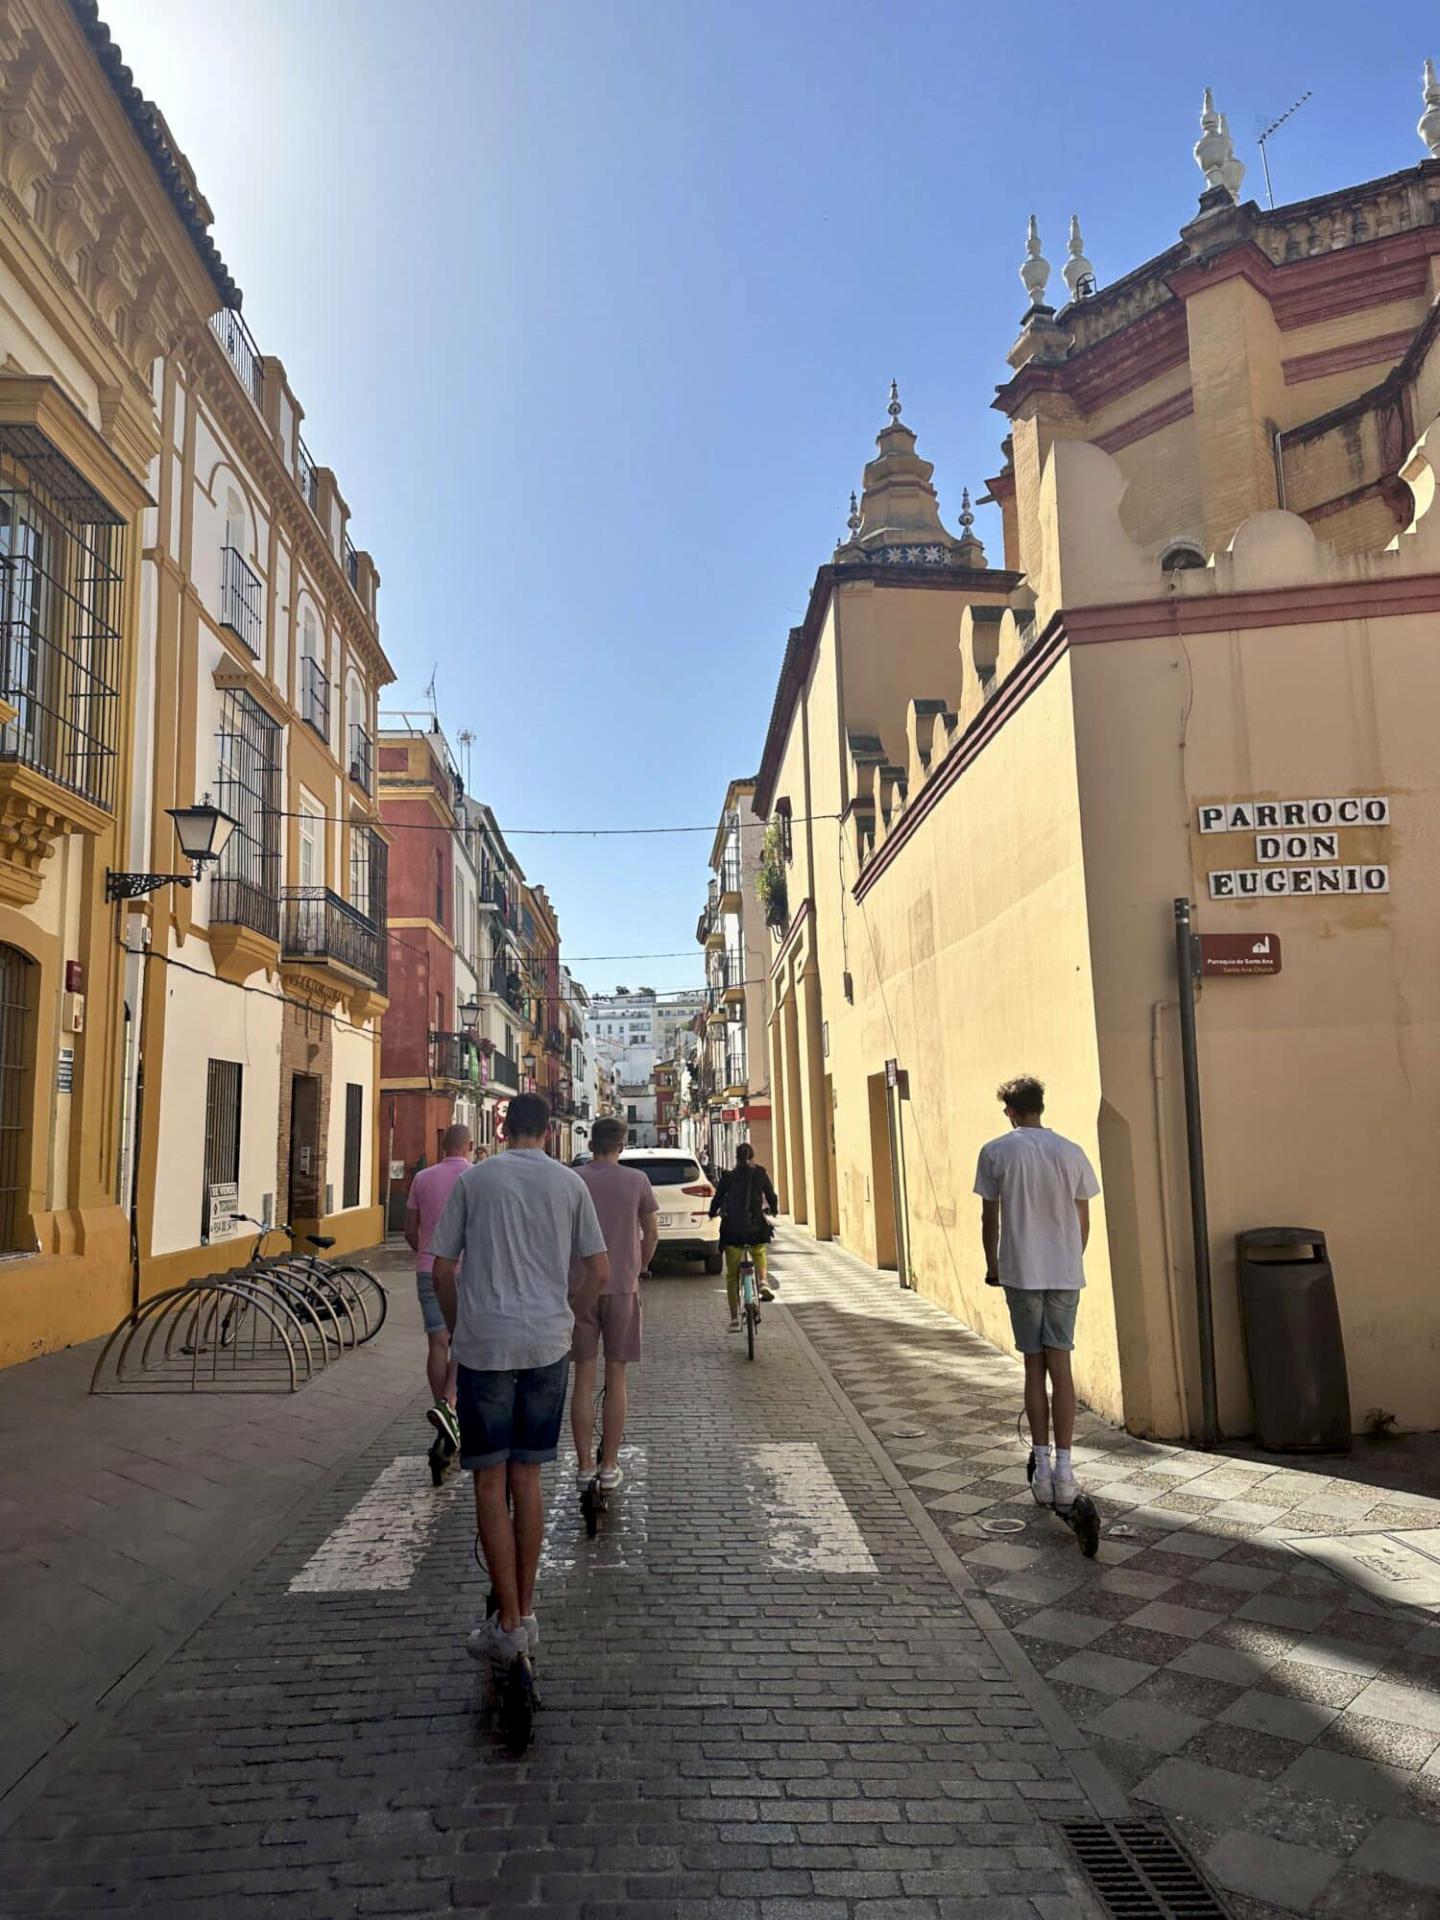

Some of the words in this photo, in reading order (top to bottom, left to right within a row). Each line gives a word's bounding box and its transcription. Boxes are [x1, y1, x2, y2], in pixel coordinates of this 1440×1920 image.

[1202, 800, 1387, 830] PARROCO
[1259, 835, 1336, 859] DON
[1211, 868, 1387, 896] EUGENIO
[1207, 958, 1236, 966] Parroquia
